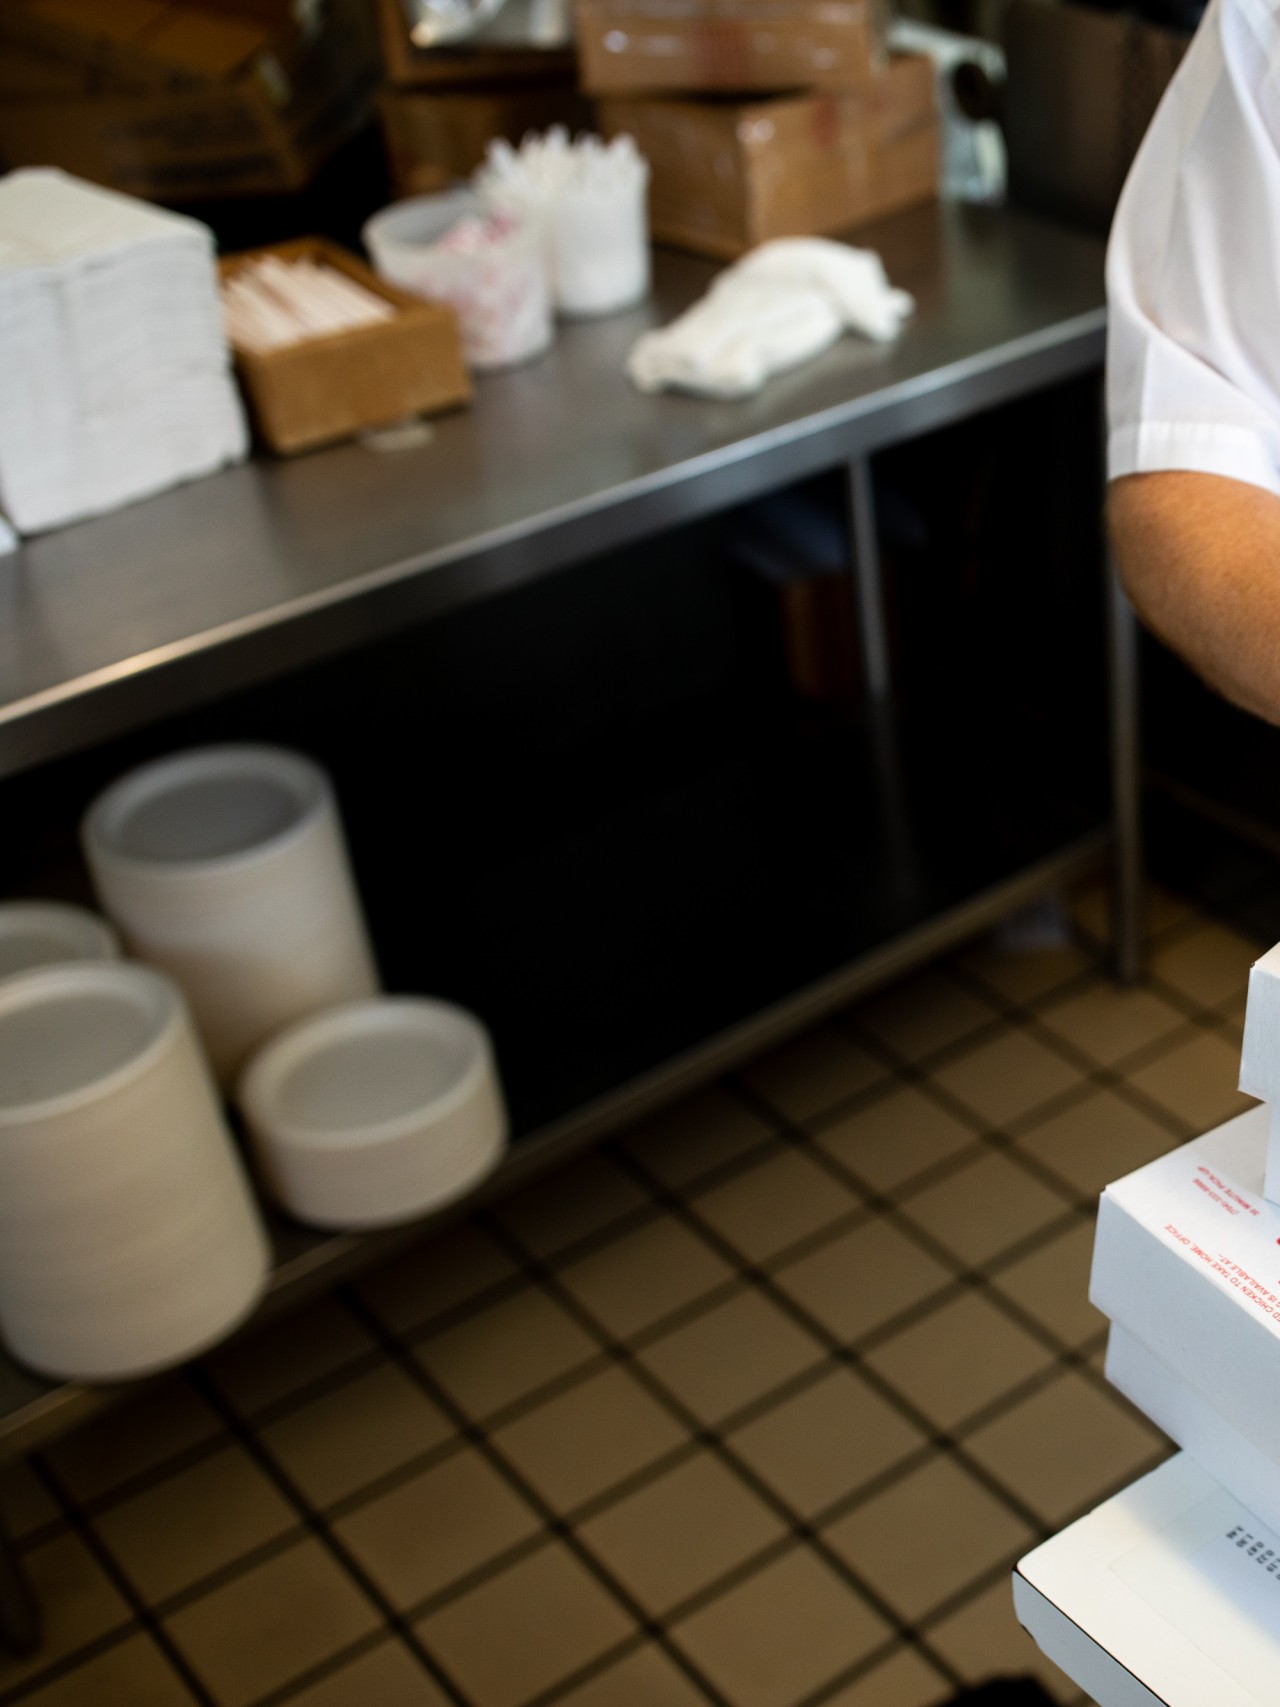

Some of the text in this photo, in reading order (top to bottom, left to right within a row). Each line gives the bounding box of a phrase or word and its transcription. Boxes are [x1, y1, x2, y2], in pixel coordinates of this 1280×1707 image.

[1211, 1261, 1230, 1279] TAKE
[1228, 1277, 1244, 1288] TO
[1229, 1264, 1269, 1295] AVAILABLE
[1240, 1286, 1274, 1313] CHICKEN
[1267, 1294, 1277, 1303] IS
